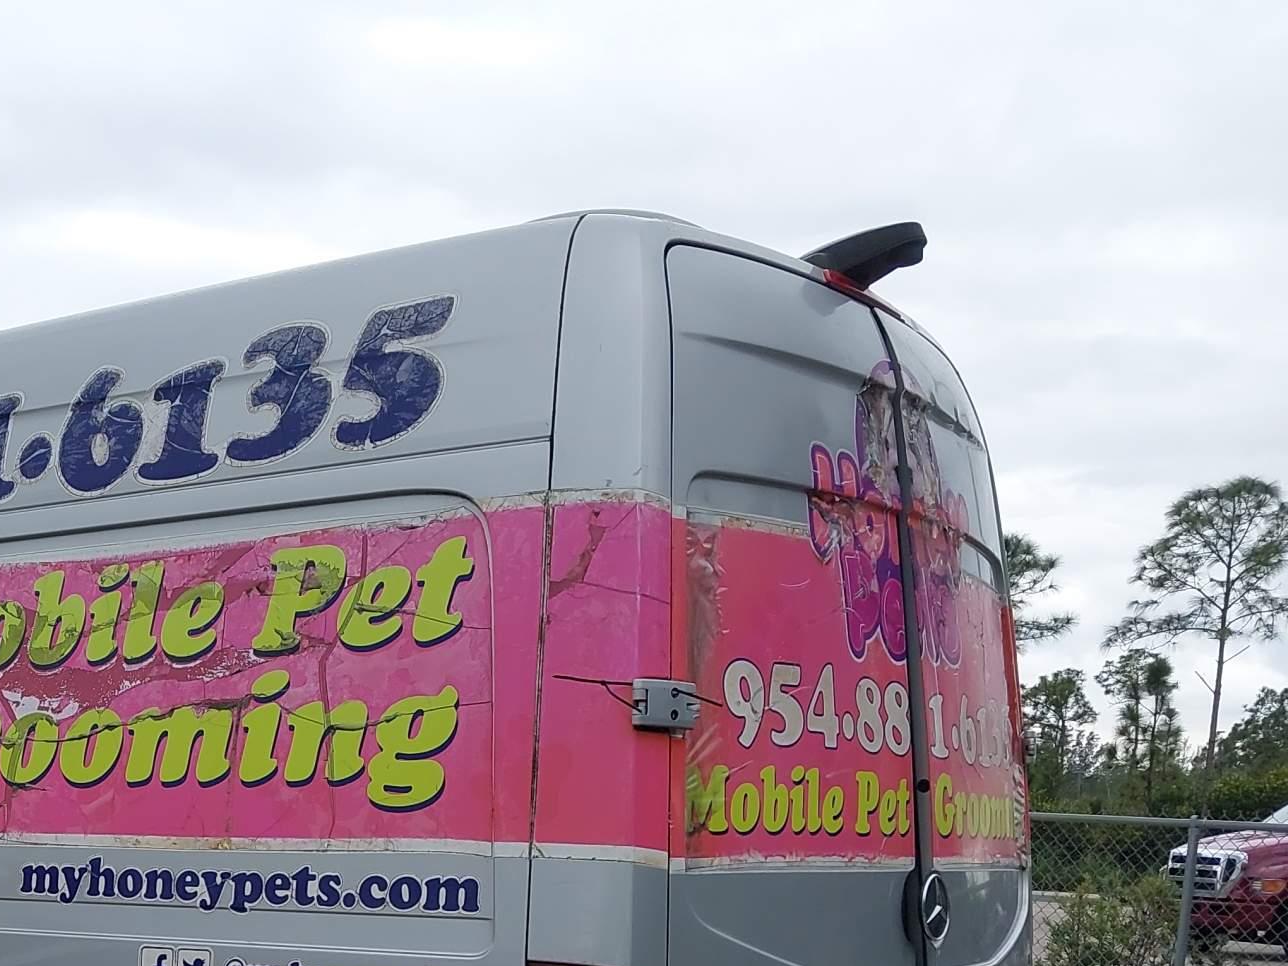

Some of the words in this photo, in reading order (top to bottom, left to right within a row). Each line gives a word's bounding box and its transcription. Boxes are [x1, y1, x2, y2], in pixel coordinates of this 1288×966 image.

[252, 535, 476, 657] Pet
[686, 764, 845, 837] Mobile
[855, 770, 911, 837] Pet
[20, 856, 481, 914] myhoneypets.com
